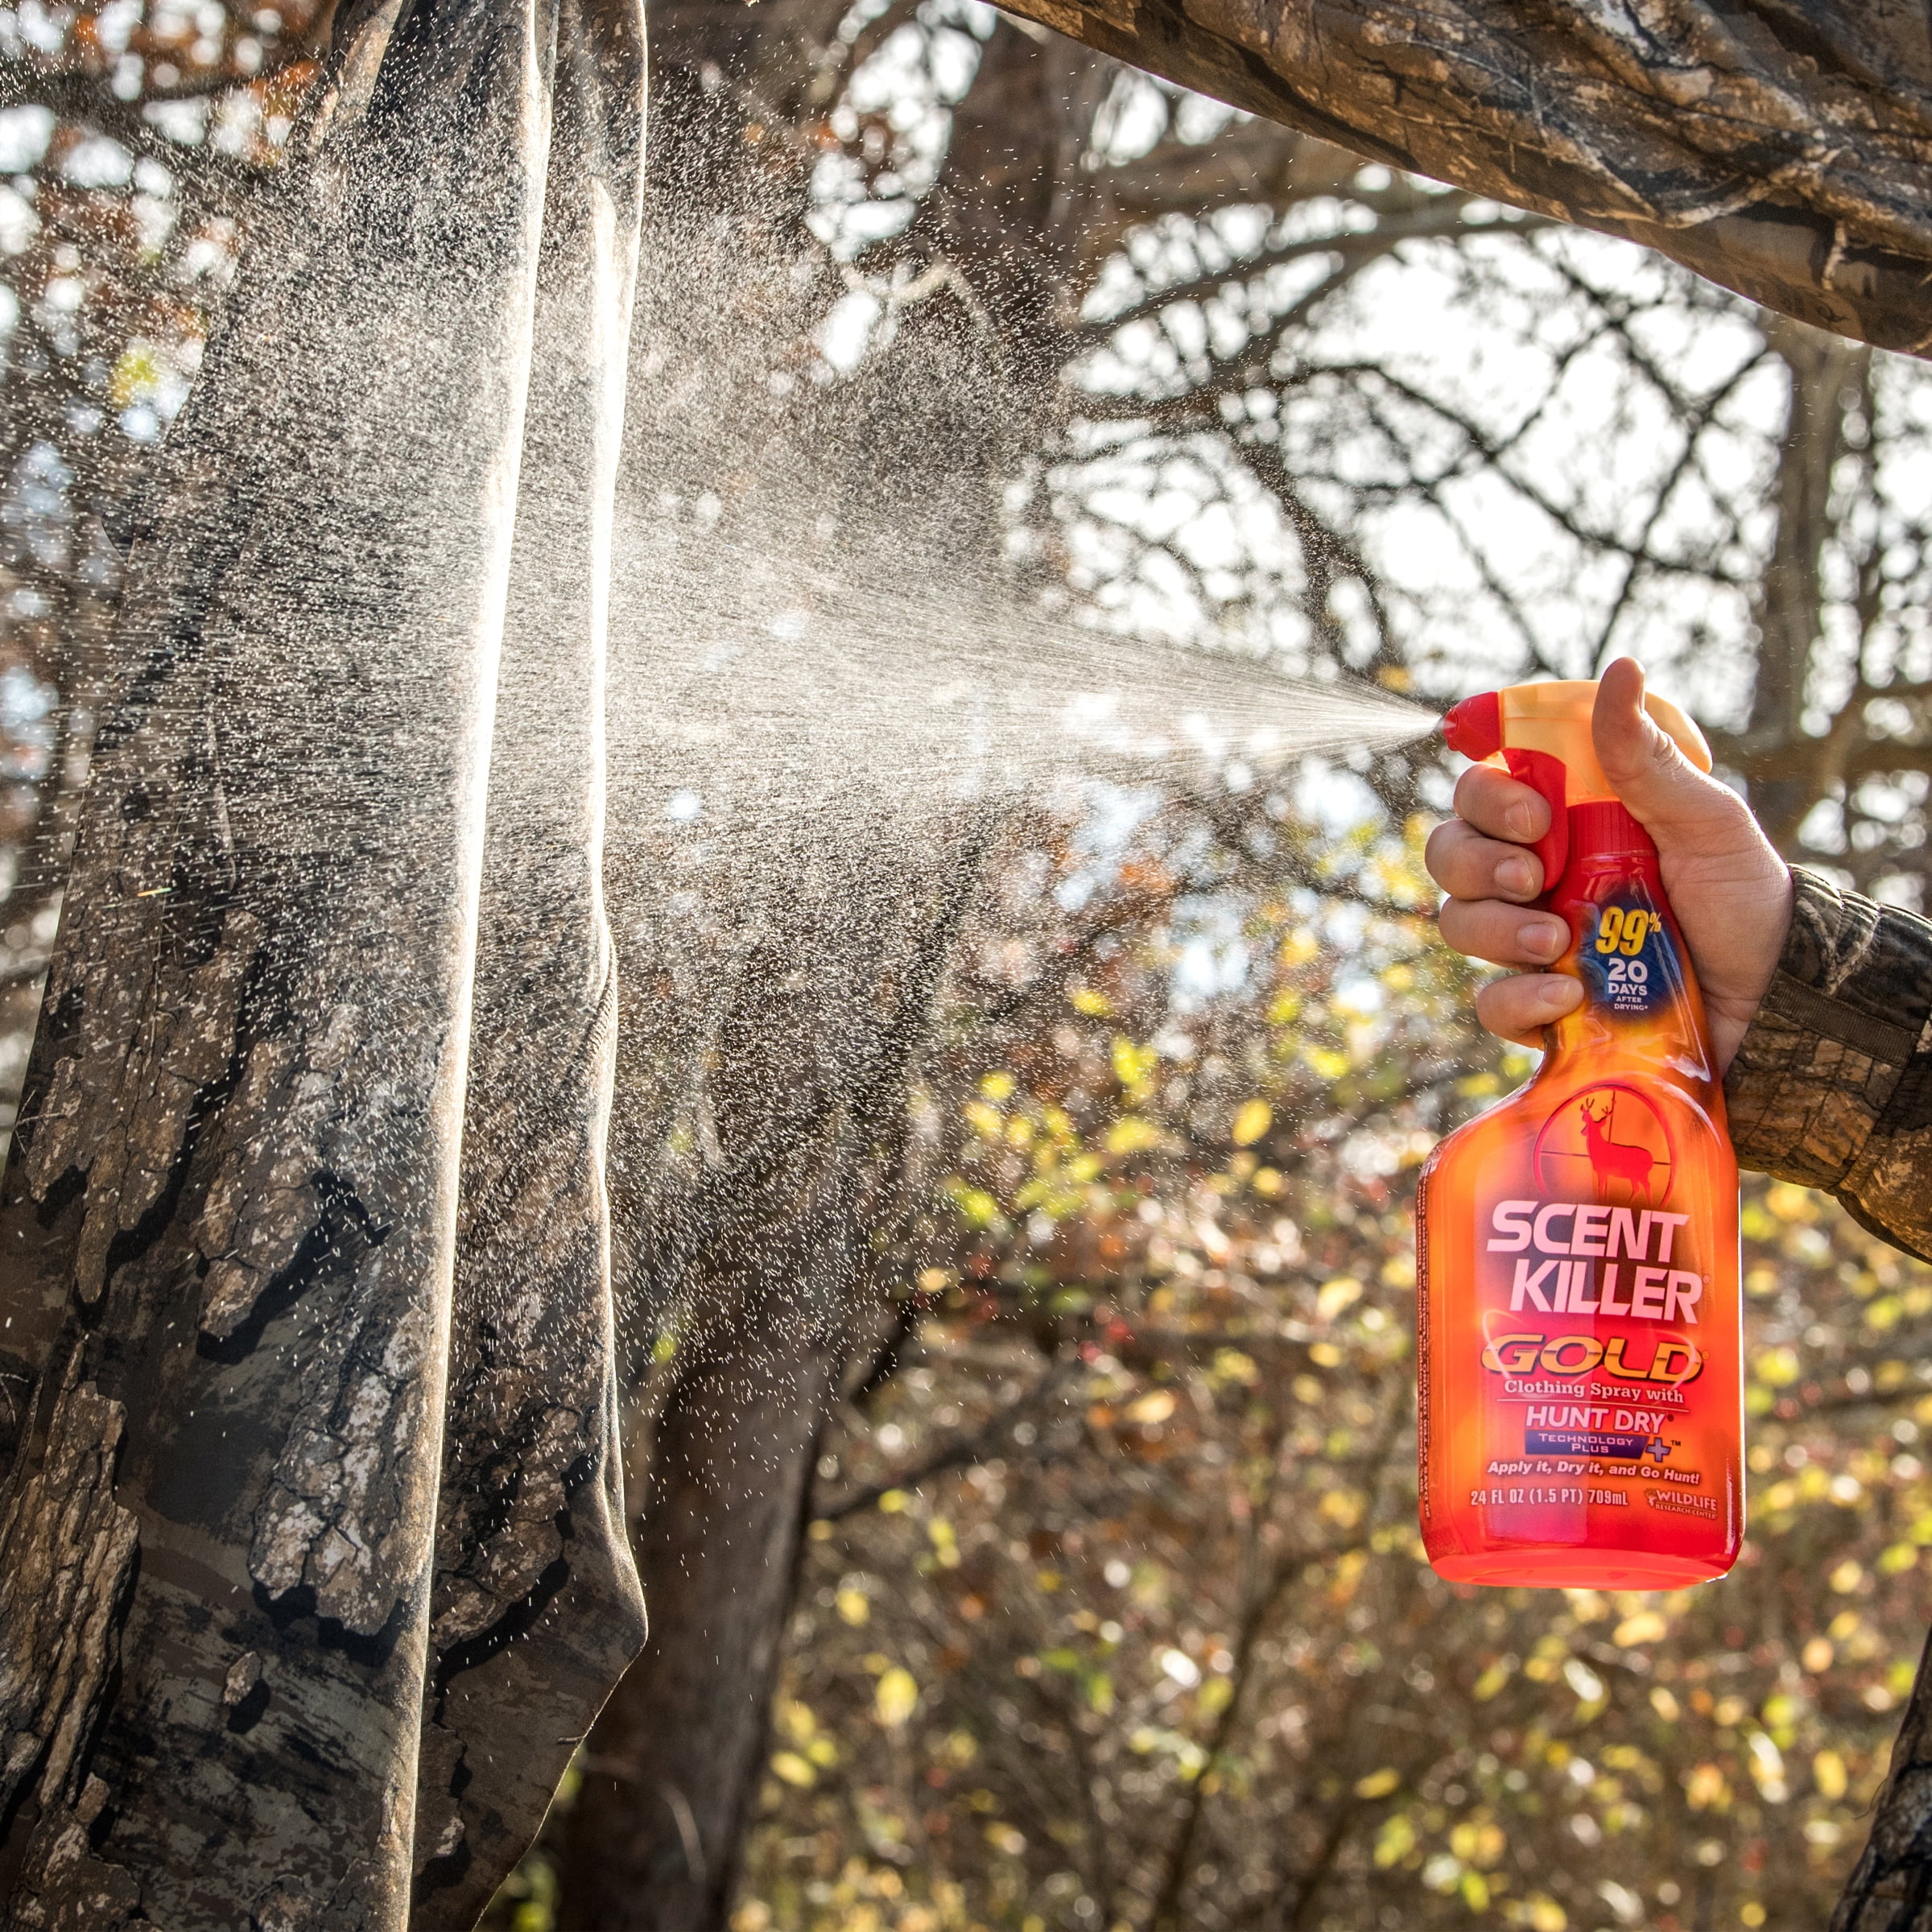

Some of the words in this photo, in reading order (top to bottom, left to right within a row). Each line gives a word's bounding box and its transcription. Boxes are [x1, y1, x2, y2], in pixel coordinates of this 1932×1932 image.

[1595, 906, 1662, 956] 99%
[1608, 958, 1648, 983] 20
[1608, 983, 1648, 996] DAYS
[1486, 1199, 1690, 1263] SCENT
[1509, 1258, 1703, 1325] KILLER
[1481, 1333, 1704, 1385] GOLD
[1504, 1379, 1585, 1398] Clothing
[1590, 1382, 1641, 1401] Spray
[1645, 1388, 1684, 1403] with
[1525, 1406, 1609, 1429] HUNT
[1614, 1410, 1666, 1434] DRY
[1538, 1433, 1633, 1446] TECHNOLOGY
[1571, 1443, 1609, 1454] PLUS
[1488, 1460, 1533, 1476] Apply
[1536, 1460, 1553, 1474] it,
[1557, 1461, 1584, 1476] Dry
[1588, 1461, 1604, 1476] it,
[1609, 1464, 1636, 1476] and
[1641, 1466, 1659, 1479] Go
[1663, 1468, 1700, 1484] Hunt!
[1470, 1489, 1487, 1506] 24
[1491, 1488, 1505, 1504] FL
[1509, 1488, 1525, 1504] OZ
[1529, 1488, 1557, 1505] (1.5
[1561, 1488, 1583, 1505] PT)
[1587, 1489, 1629, 1506] 709mL
[1655, 1504, 1690, 1514] RESEARCH
[1656, 1489, 1717, 1511] WILDLIFE
